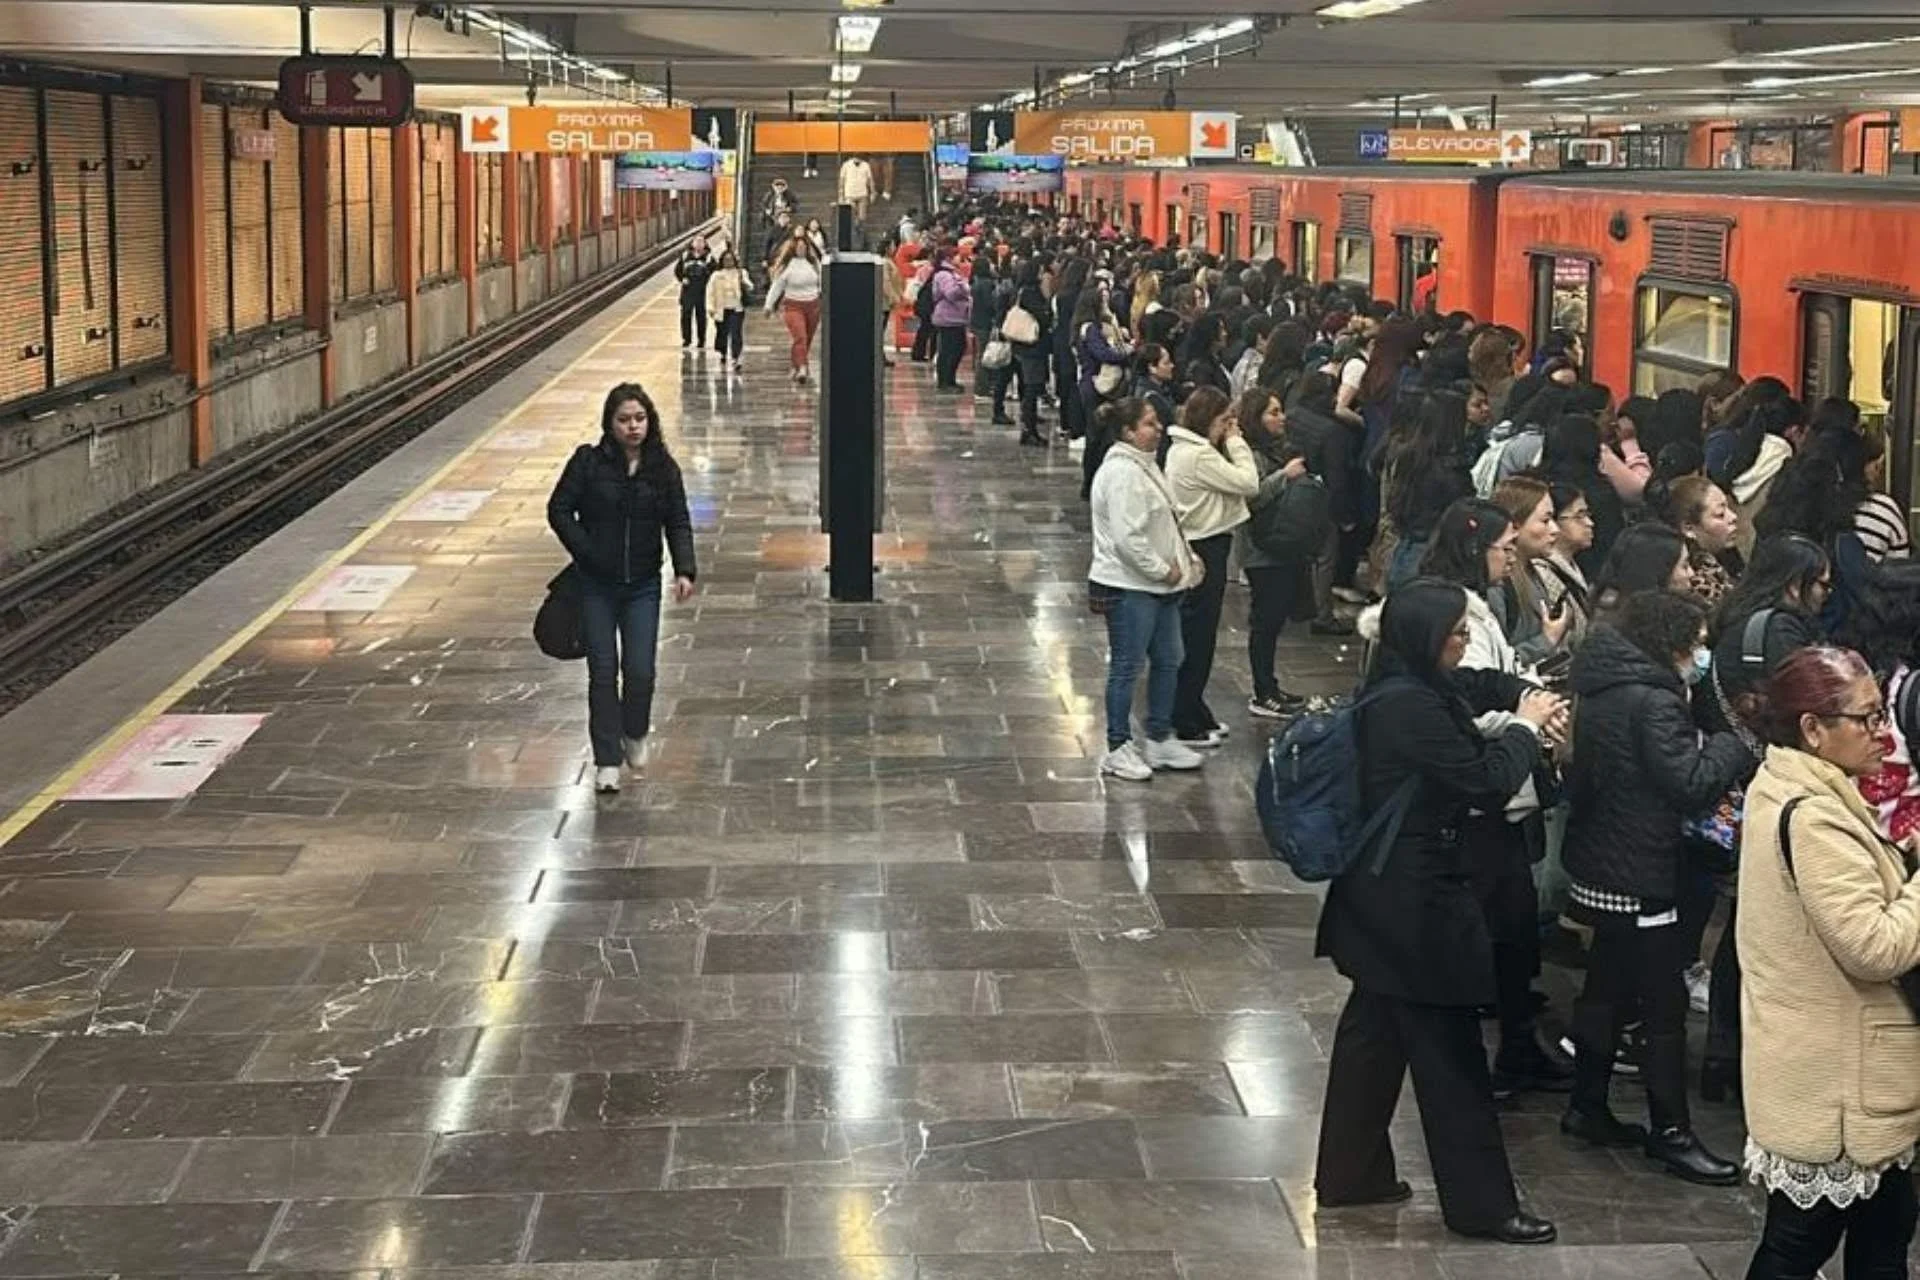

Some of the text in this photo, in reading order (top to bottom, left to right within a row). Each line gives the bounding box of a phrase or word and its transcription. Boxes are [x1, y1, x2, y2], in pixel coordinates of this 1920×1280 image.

[547, 130, 655, 150] SALIDA
[1050, 135, 1156, 154] SALIDA
[1389, 137, 1500, 150] ELEVADOR
